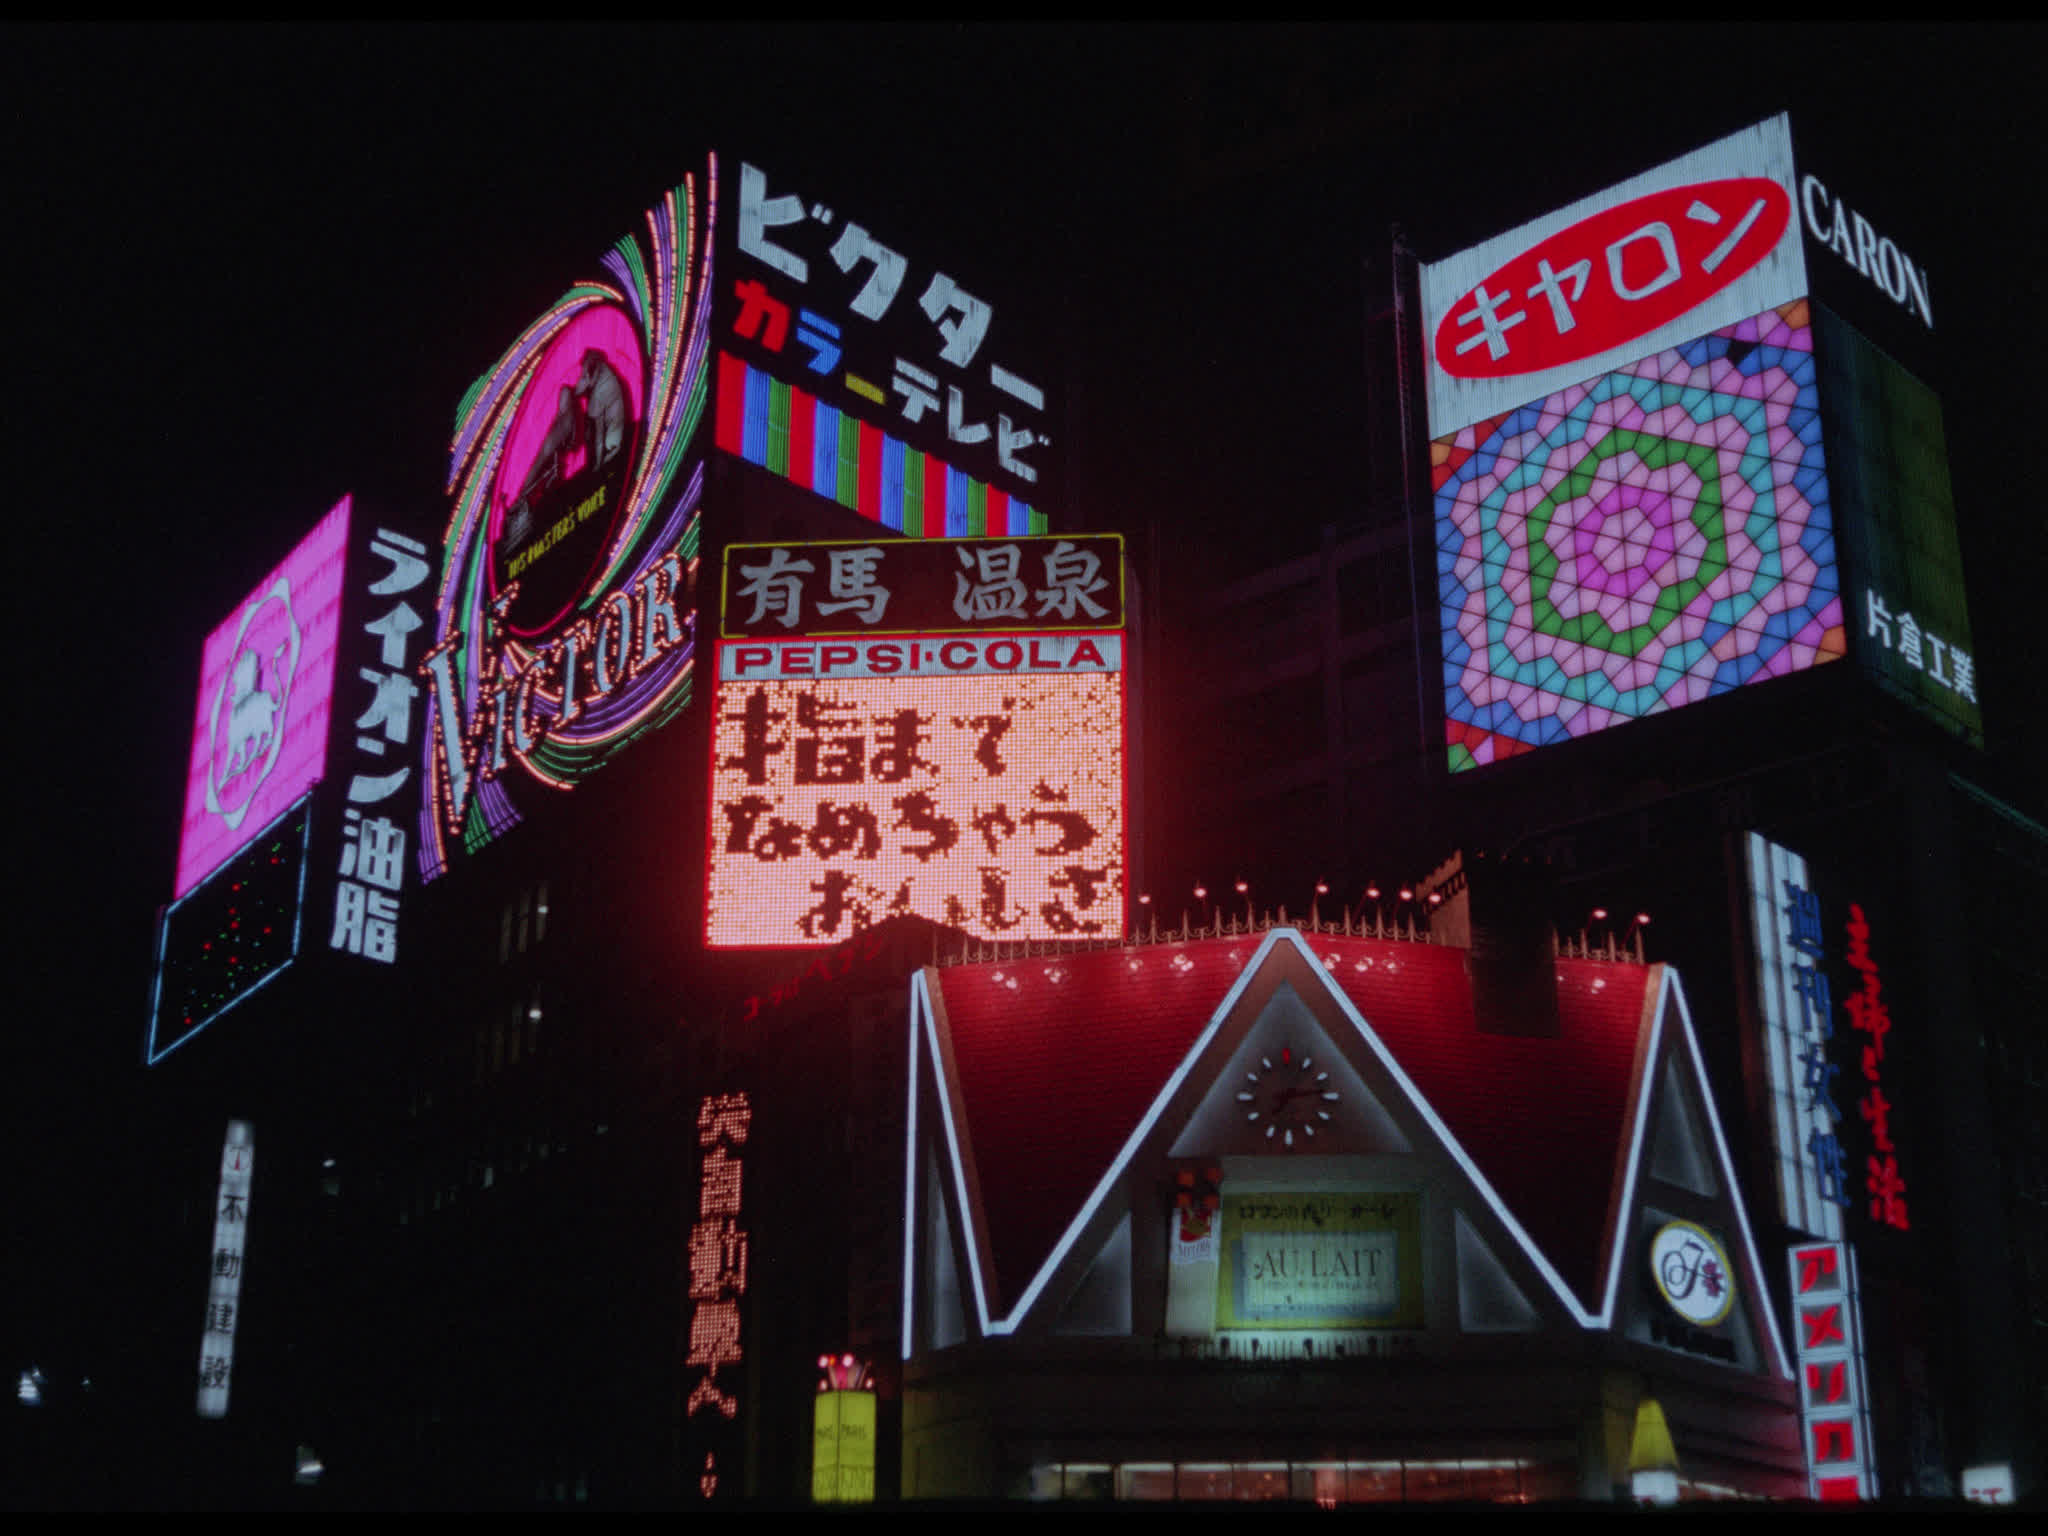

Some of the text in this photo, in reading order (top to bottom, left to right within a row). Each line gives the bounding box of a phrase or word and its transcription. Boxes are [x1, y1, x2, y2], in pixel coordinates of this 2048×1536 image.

[737, 160, 1046, 412] ビクター
[1802, 173, 1934, 330] CARON
[732, 278, 1052, 484] カラーテレビ
[329, 526, 431, 965] ライオン油脂
[418, 550, 685, 836] VICTOR
[1866, 587, 1978, 704] 片倉工業
[1784, 879, 1853, 1209] 週刊女性
[201, 1194, 245, 1390] 不動建設
